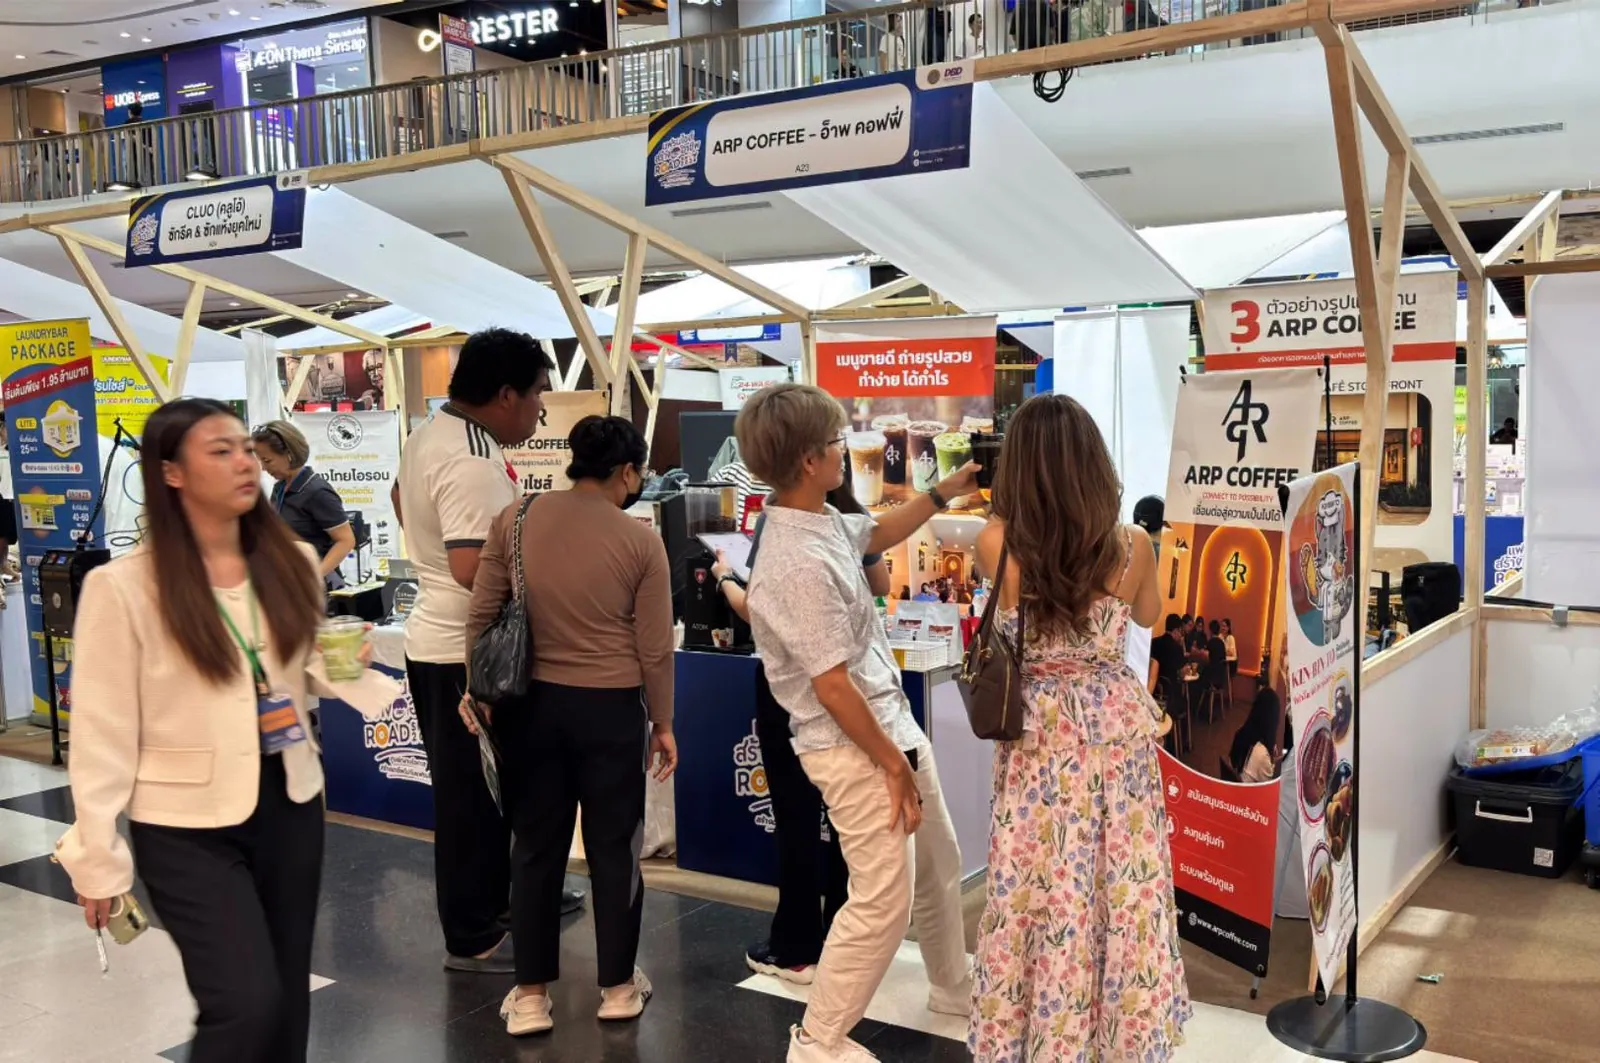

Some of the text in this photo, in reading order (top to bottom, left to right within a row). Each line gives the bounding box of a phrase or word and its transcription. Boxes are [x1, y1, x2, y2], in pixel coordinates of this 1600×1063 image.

[285, 45, 322, 61] Thana
[323, 38, 366, 54] Sinsap
[712, 137, 743, 155] ARP
[746, 128, 806, 151] COFFEE
[855, 105, 904, 136] คอฟฟี่
[795, 163, 810, 173] A23
[186, 203, 215, 220] CLUO
[194, 225, 201, 238] &
[1230, 300, 1260, 344] 3
[1267, 317, 1318, 338] ARP
[15, 327, 69, 341] LAUNDRYBAR
[10, 341, 76, 361] PACKAGE
[836, 348, 973, 371] เมนูขายดี ถ่ายรูปสวย
[41, 372, 59, 389] 1.95
[858, 368, 949, 387] ทำง่าย ได้กำไร
[527, 438, 571, 450] COFFEE
[1184, 465, 1223, 486] ARP
[365, 722, 410, 748] ROAD
[1179, 863, 1235, 893] ระบบพร้อมดูแล
[1197, 918, 1258, 952] www.arpcoffee.com
